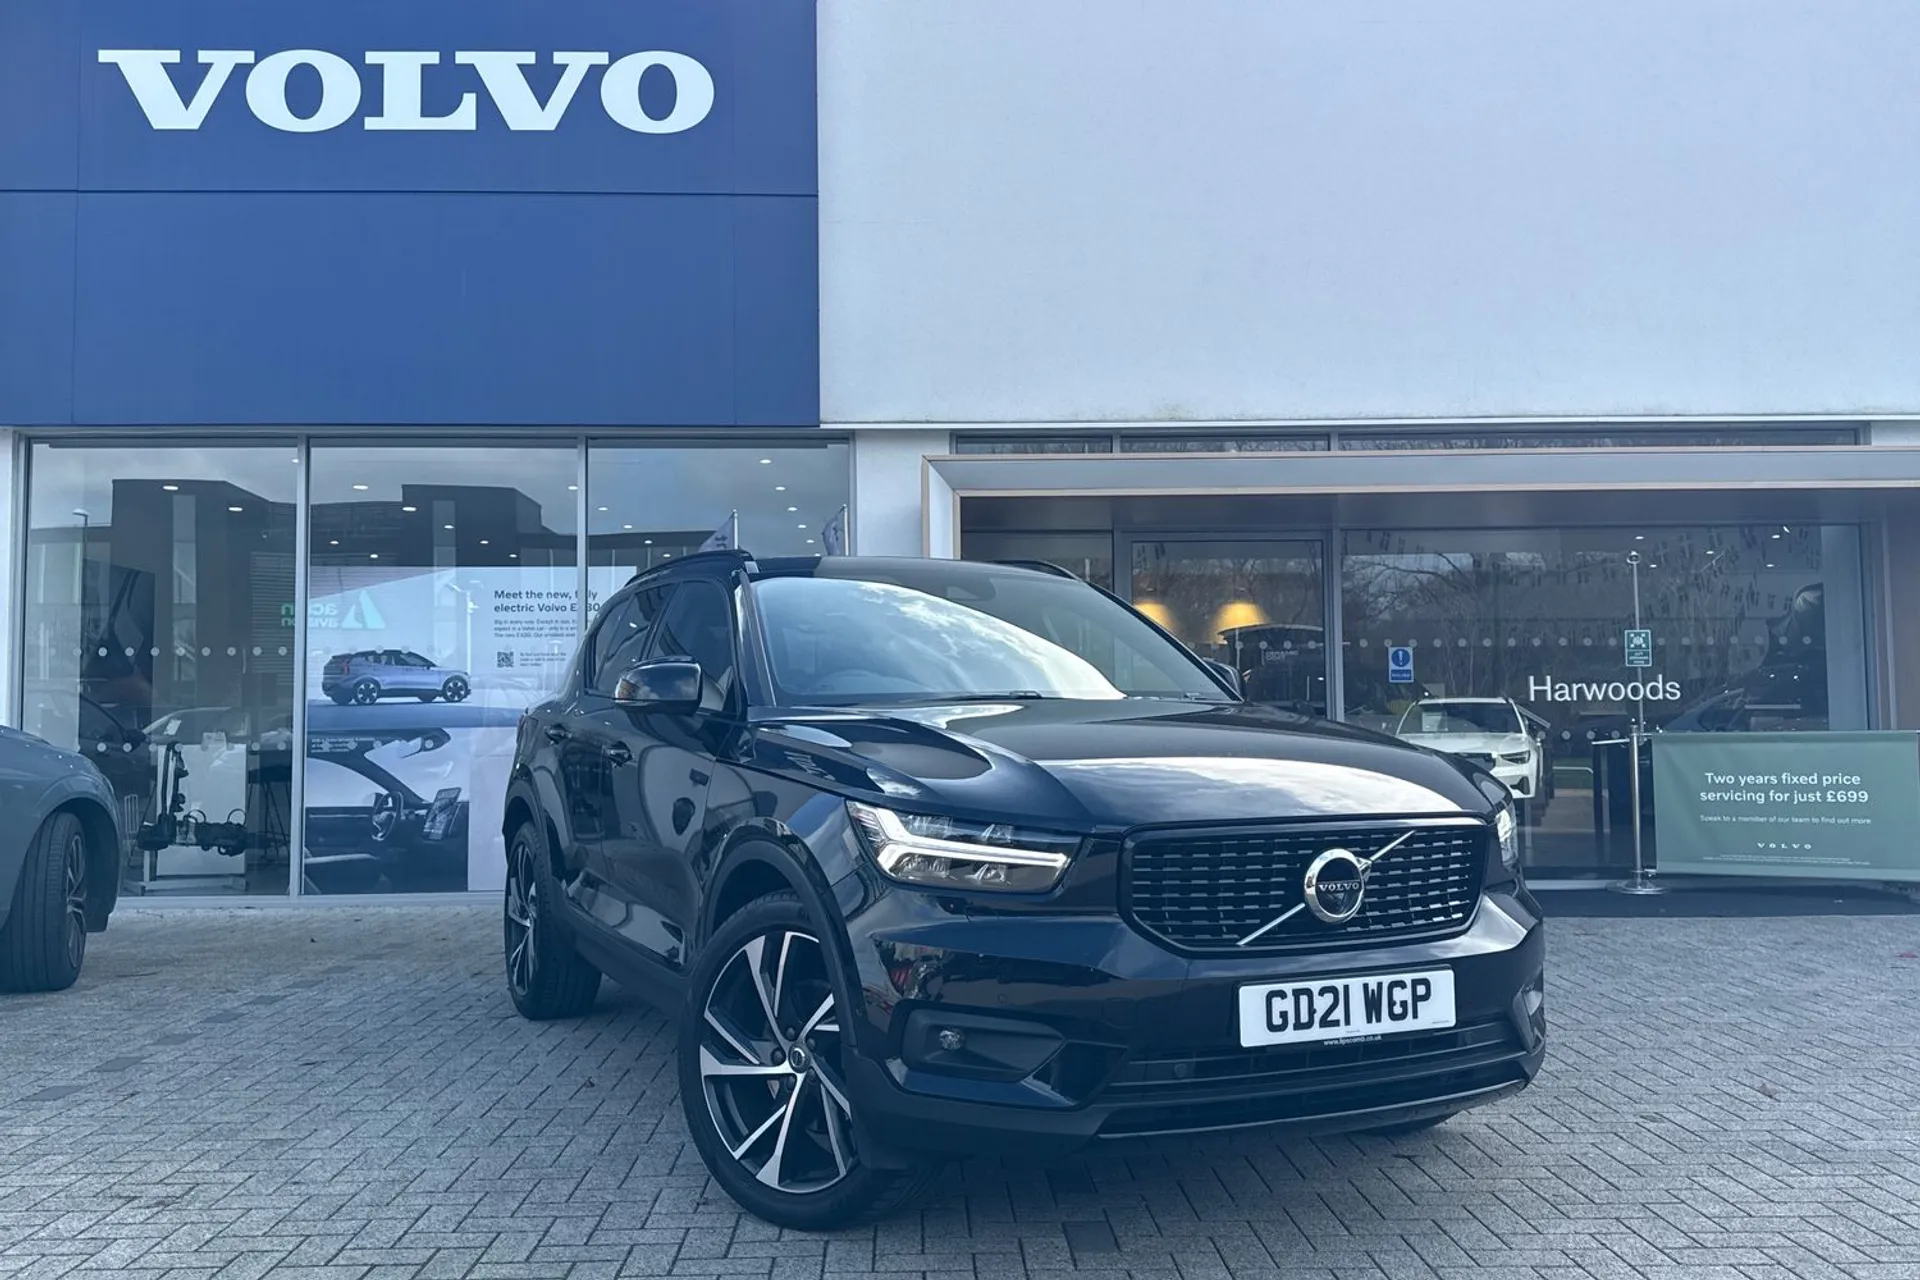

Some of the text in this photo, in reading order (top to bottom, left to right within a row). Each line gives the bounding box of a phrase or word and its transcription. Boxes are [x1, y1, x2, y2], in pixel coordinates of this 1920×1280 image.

[97, 49, 715, 134] VOLVO
[494, 590, 598, 600] Meet the new, fly
[494, 603, 601, 612] electric Volvo E30
[1528, 674, 1681, 701] Harwoods
[1704, 772, 1861, 787] Two years fixed price
[1699, 790, 1869, 805] servicing for just £699
[1757, 842, 1812, 850] VOLVO
[1319, 882, 1360, 892] VOLVO
[1265, 977, 1432, 1033] GD21 WGP
